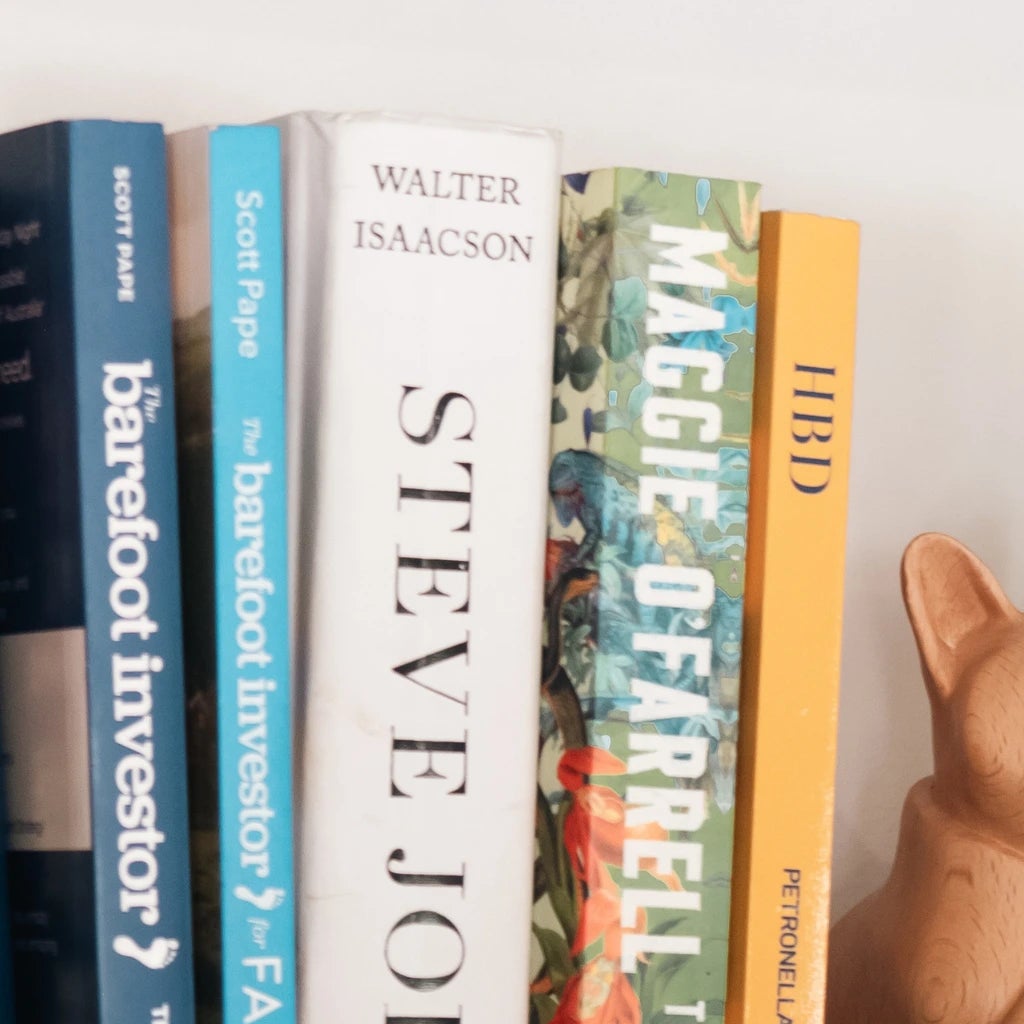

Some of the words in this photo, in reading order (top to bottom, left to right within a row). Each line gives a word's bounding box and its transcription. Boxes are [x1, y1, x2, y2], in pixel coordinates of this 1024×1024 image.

[112, 165, 134, 239] SCOTT
[371, 164, 522, 206] WALTER
[115, 242, 136, 302] PAPE
[233, 189, 265, 272] Scott
[353, 220, 534, 263] ISAACSON
[229, 279, 266, 359] Pape
[143, 383, 163, 424] The
[637, 223, 729, 522] MAGGIE
[241, 417, 263, 458] The
[788, 361, 837, 497] HBD
[102, 359, 160, 642] barefoot
[232, 460, 274, 668] barefoot
[390, 384, 477, 799] STEVE
[110, 652, 166, 926] investor
[235, 674, 276, 878] investor
[619, 563, 716, 975] O'FARRELL
[246, 917, 268, 950] for
